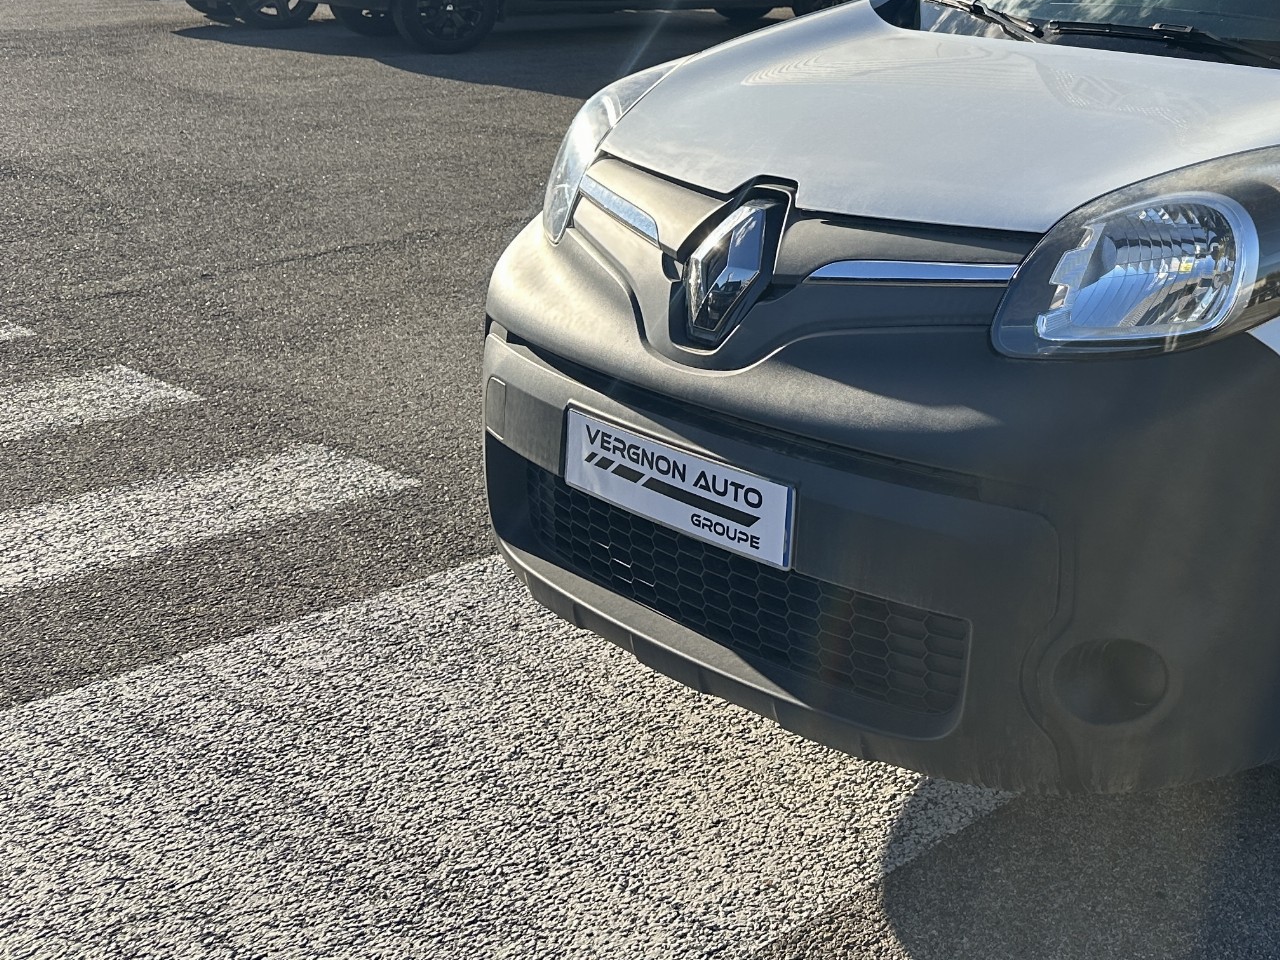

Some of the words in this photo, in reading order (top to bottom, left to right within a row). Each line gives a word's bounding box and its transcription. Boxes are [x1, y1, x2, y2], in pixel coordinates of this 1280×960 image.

[585, 424, 687, 482] VERGNON
[693, 470, 763, 509] AUTO
[691, 513, 760, 550] GROUPE
